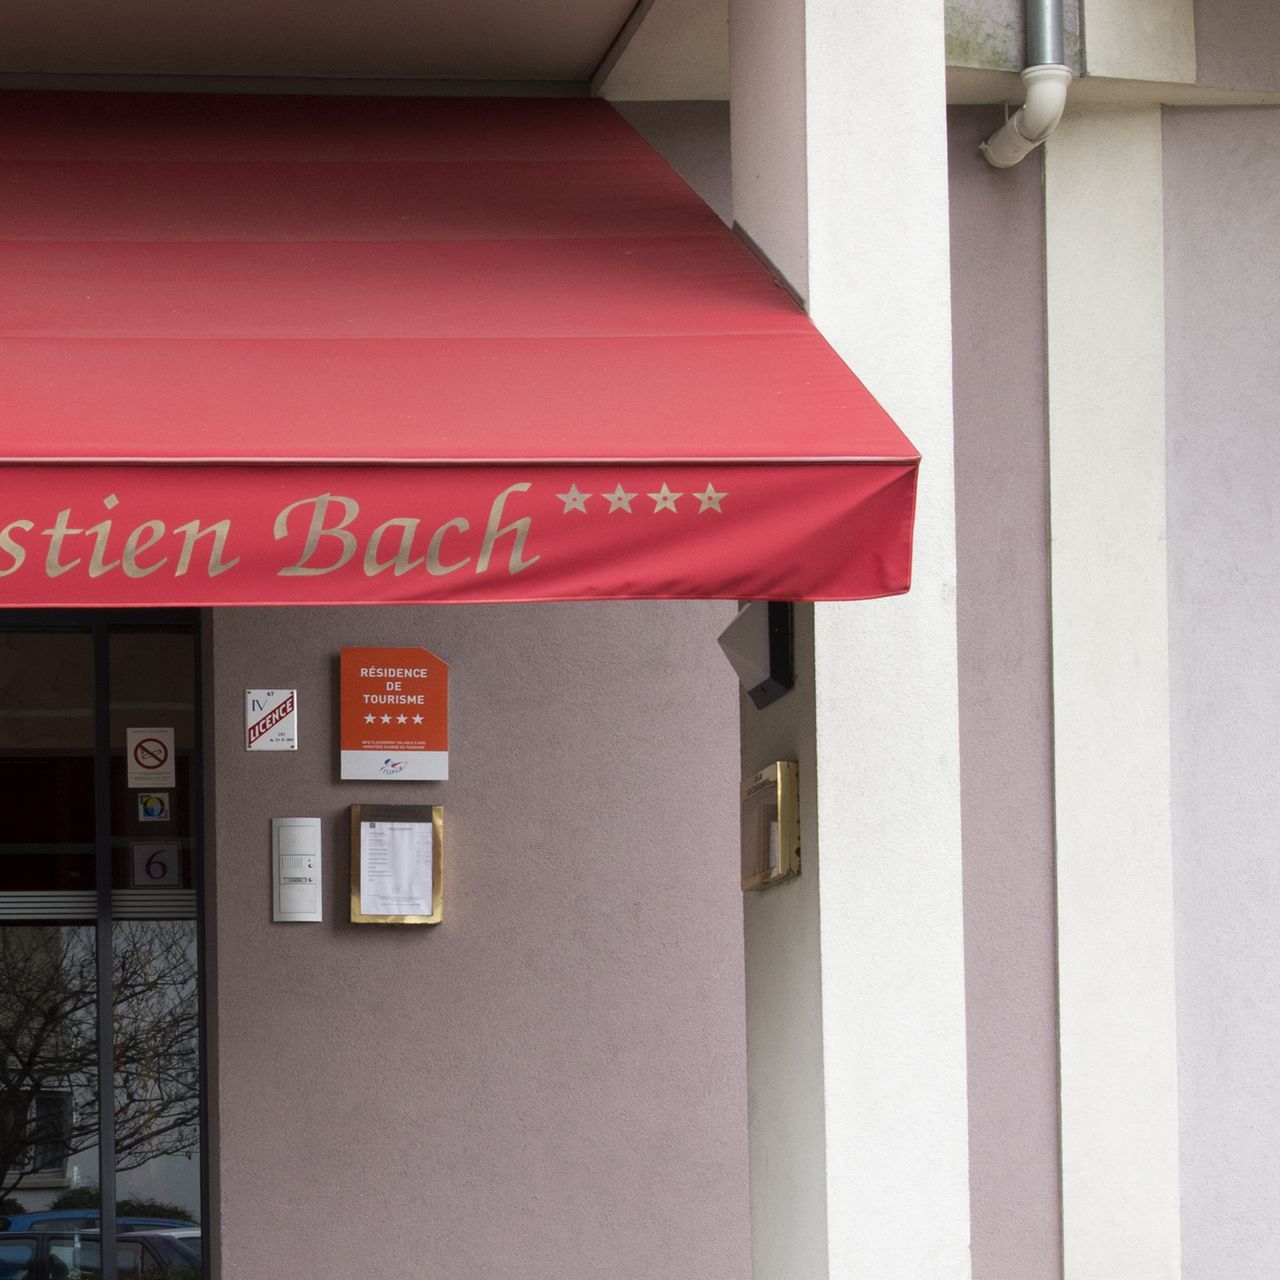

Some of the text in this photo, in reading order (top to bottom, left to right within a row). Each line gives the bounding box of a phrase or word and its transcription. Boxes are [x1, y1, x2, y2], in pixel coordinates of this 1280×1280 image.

[273, 482, 541, 578] Bach
[360, 666, 428, 678] RÉSIDENCE
[386, 681, 402, 691] DE
[252, 699, 267, 711] IV
[363, 694, 425, 705] TOURISME
[250, 698, 293, 742] LICENCE
[145, 849, 167, 880] 6
